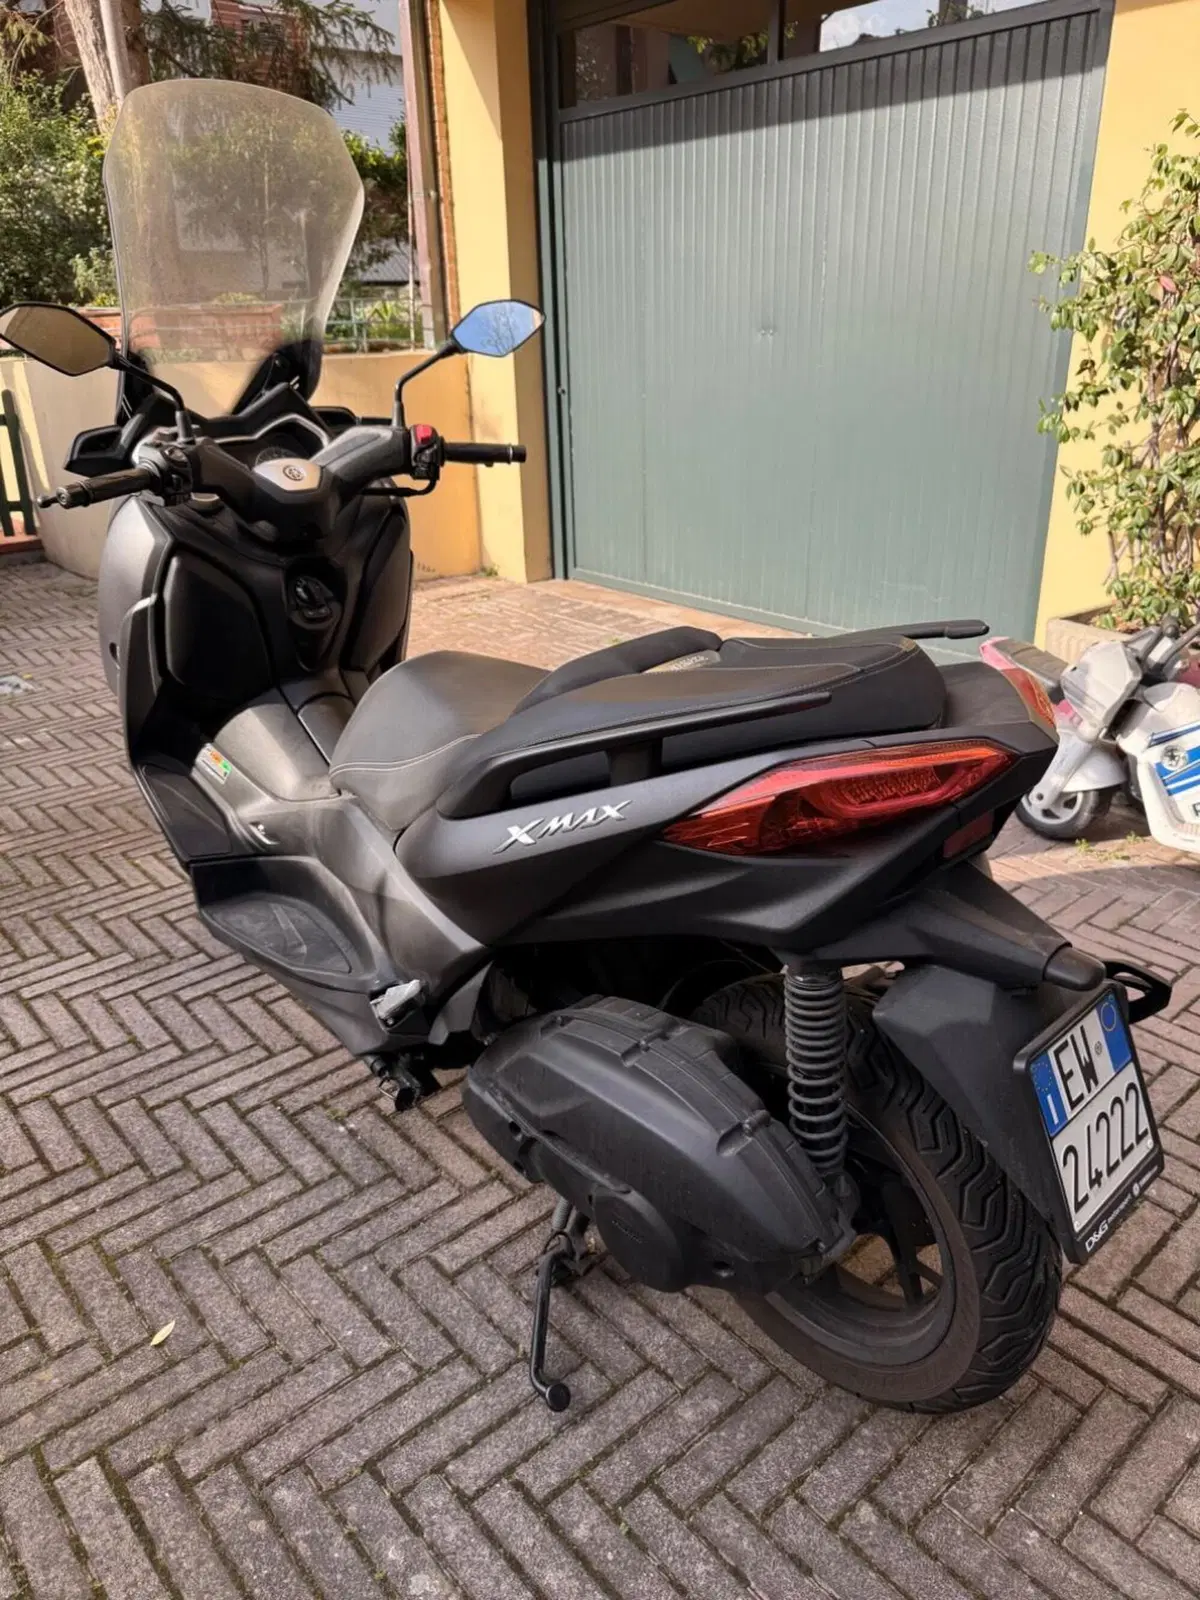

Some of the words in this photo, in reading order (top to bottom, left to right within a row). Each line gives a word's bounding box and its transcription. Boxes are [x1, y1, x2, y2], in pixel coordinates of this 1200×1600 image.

[1052, 1024, 1100, 1111] EW
[1062, 1081, 1149, 1214] 24222
[1085, 1219, 1109, 1253] D&G
